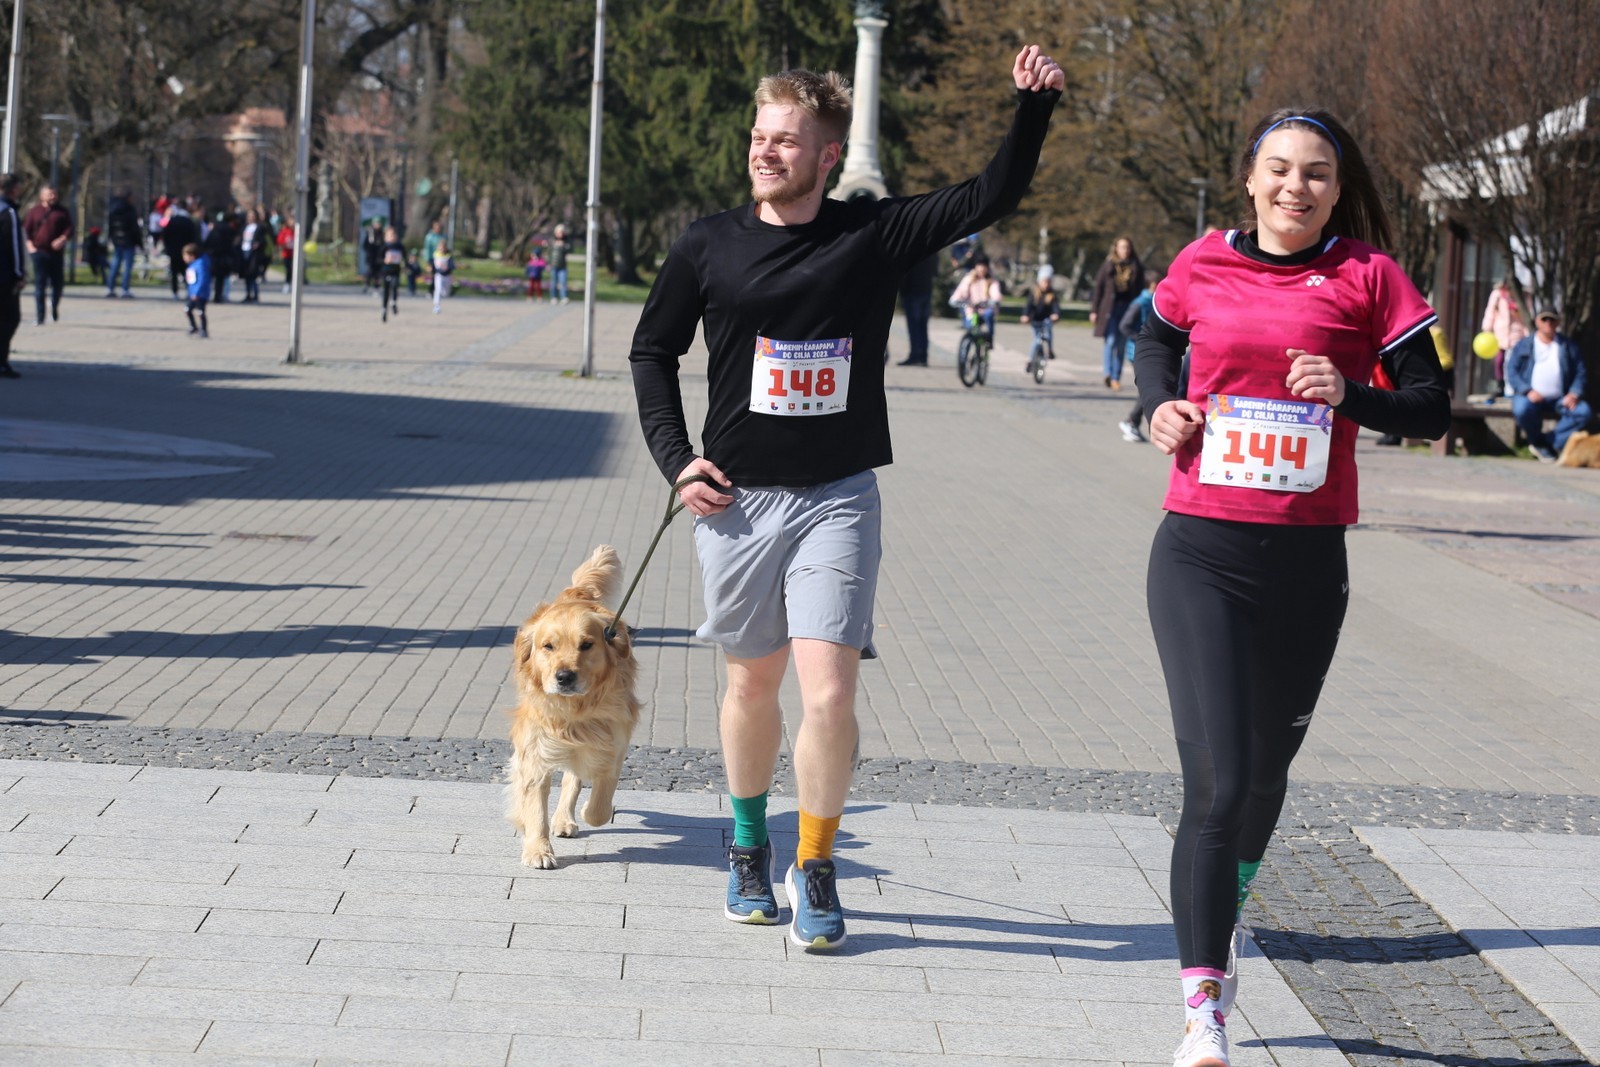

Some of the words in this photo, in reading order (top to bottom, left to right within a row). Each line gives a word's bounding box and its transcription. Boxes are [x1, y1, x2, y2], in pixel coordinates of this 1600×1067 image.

[804, 342, 834, 350] ČARAPAMA
[768, 368, 836, 397] 148
[1266, 401, 1308, 414] ČARAPAMA
[1241, 409, 1252, 418] DO
[1254, 410, 1275, 421] CILJA
[1222, 430, 1308, 470] 144
